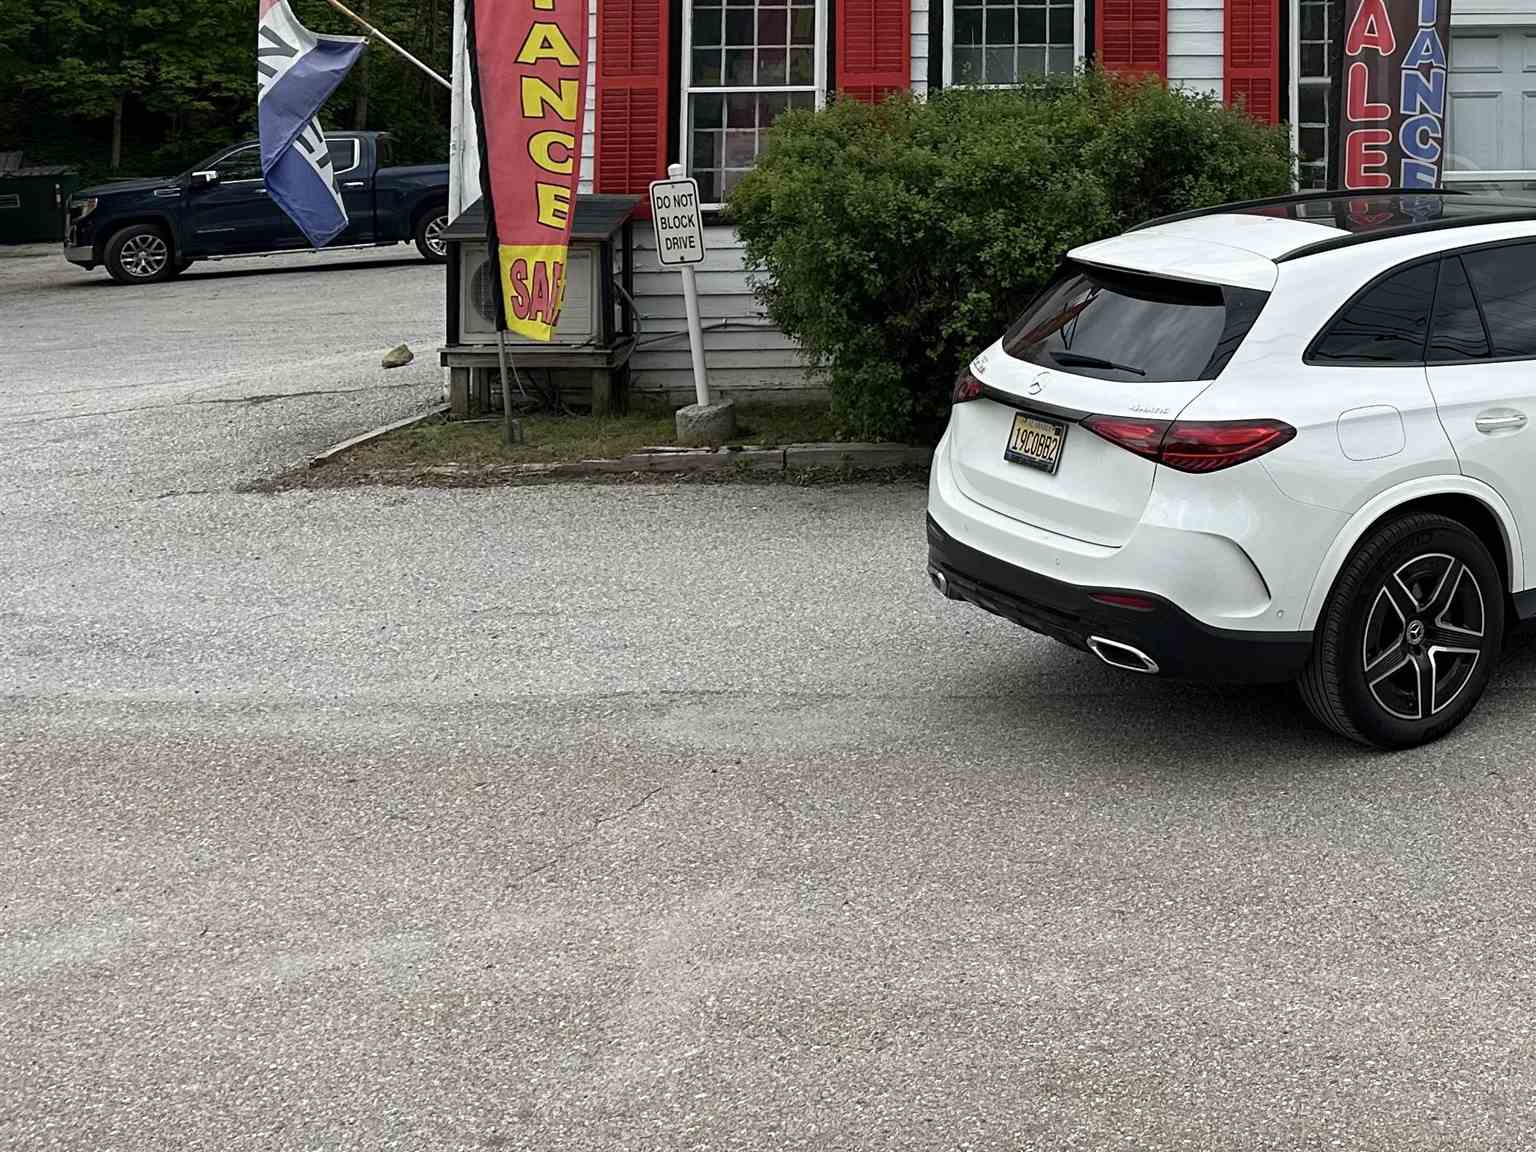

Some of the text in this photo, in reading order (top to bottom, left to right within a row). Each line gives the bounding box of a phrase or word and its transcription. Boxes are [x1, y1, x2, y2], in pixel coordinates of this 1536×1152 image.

[656, 193, 693, 209] DO NOT
[661, 214, 696, 230] BLOCK
[665, 235, 696, 250] DRIVE
